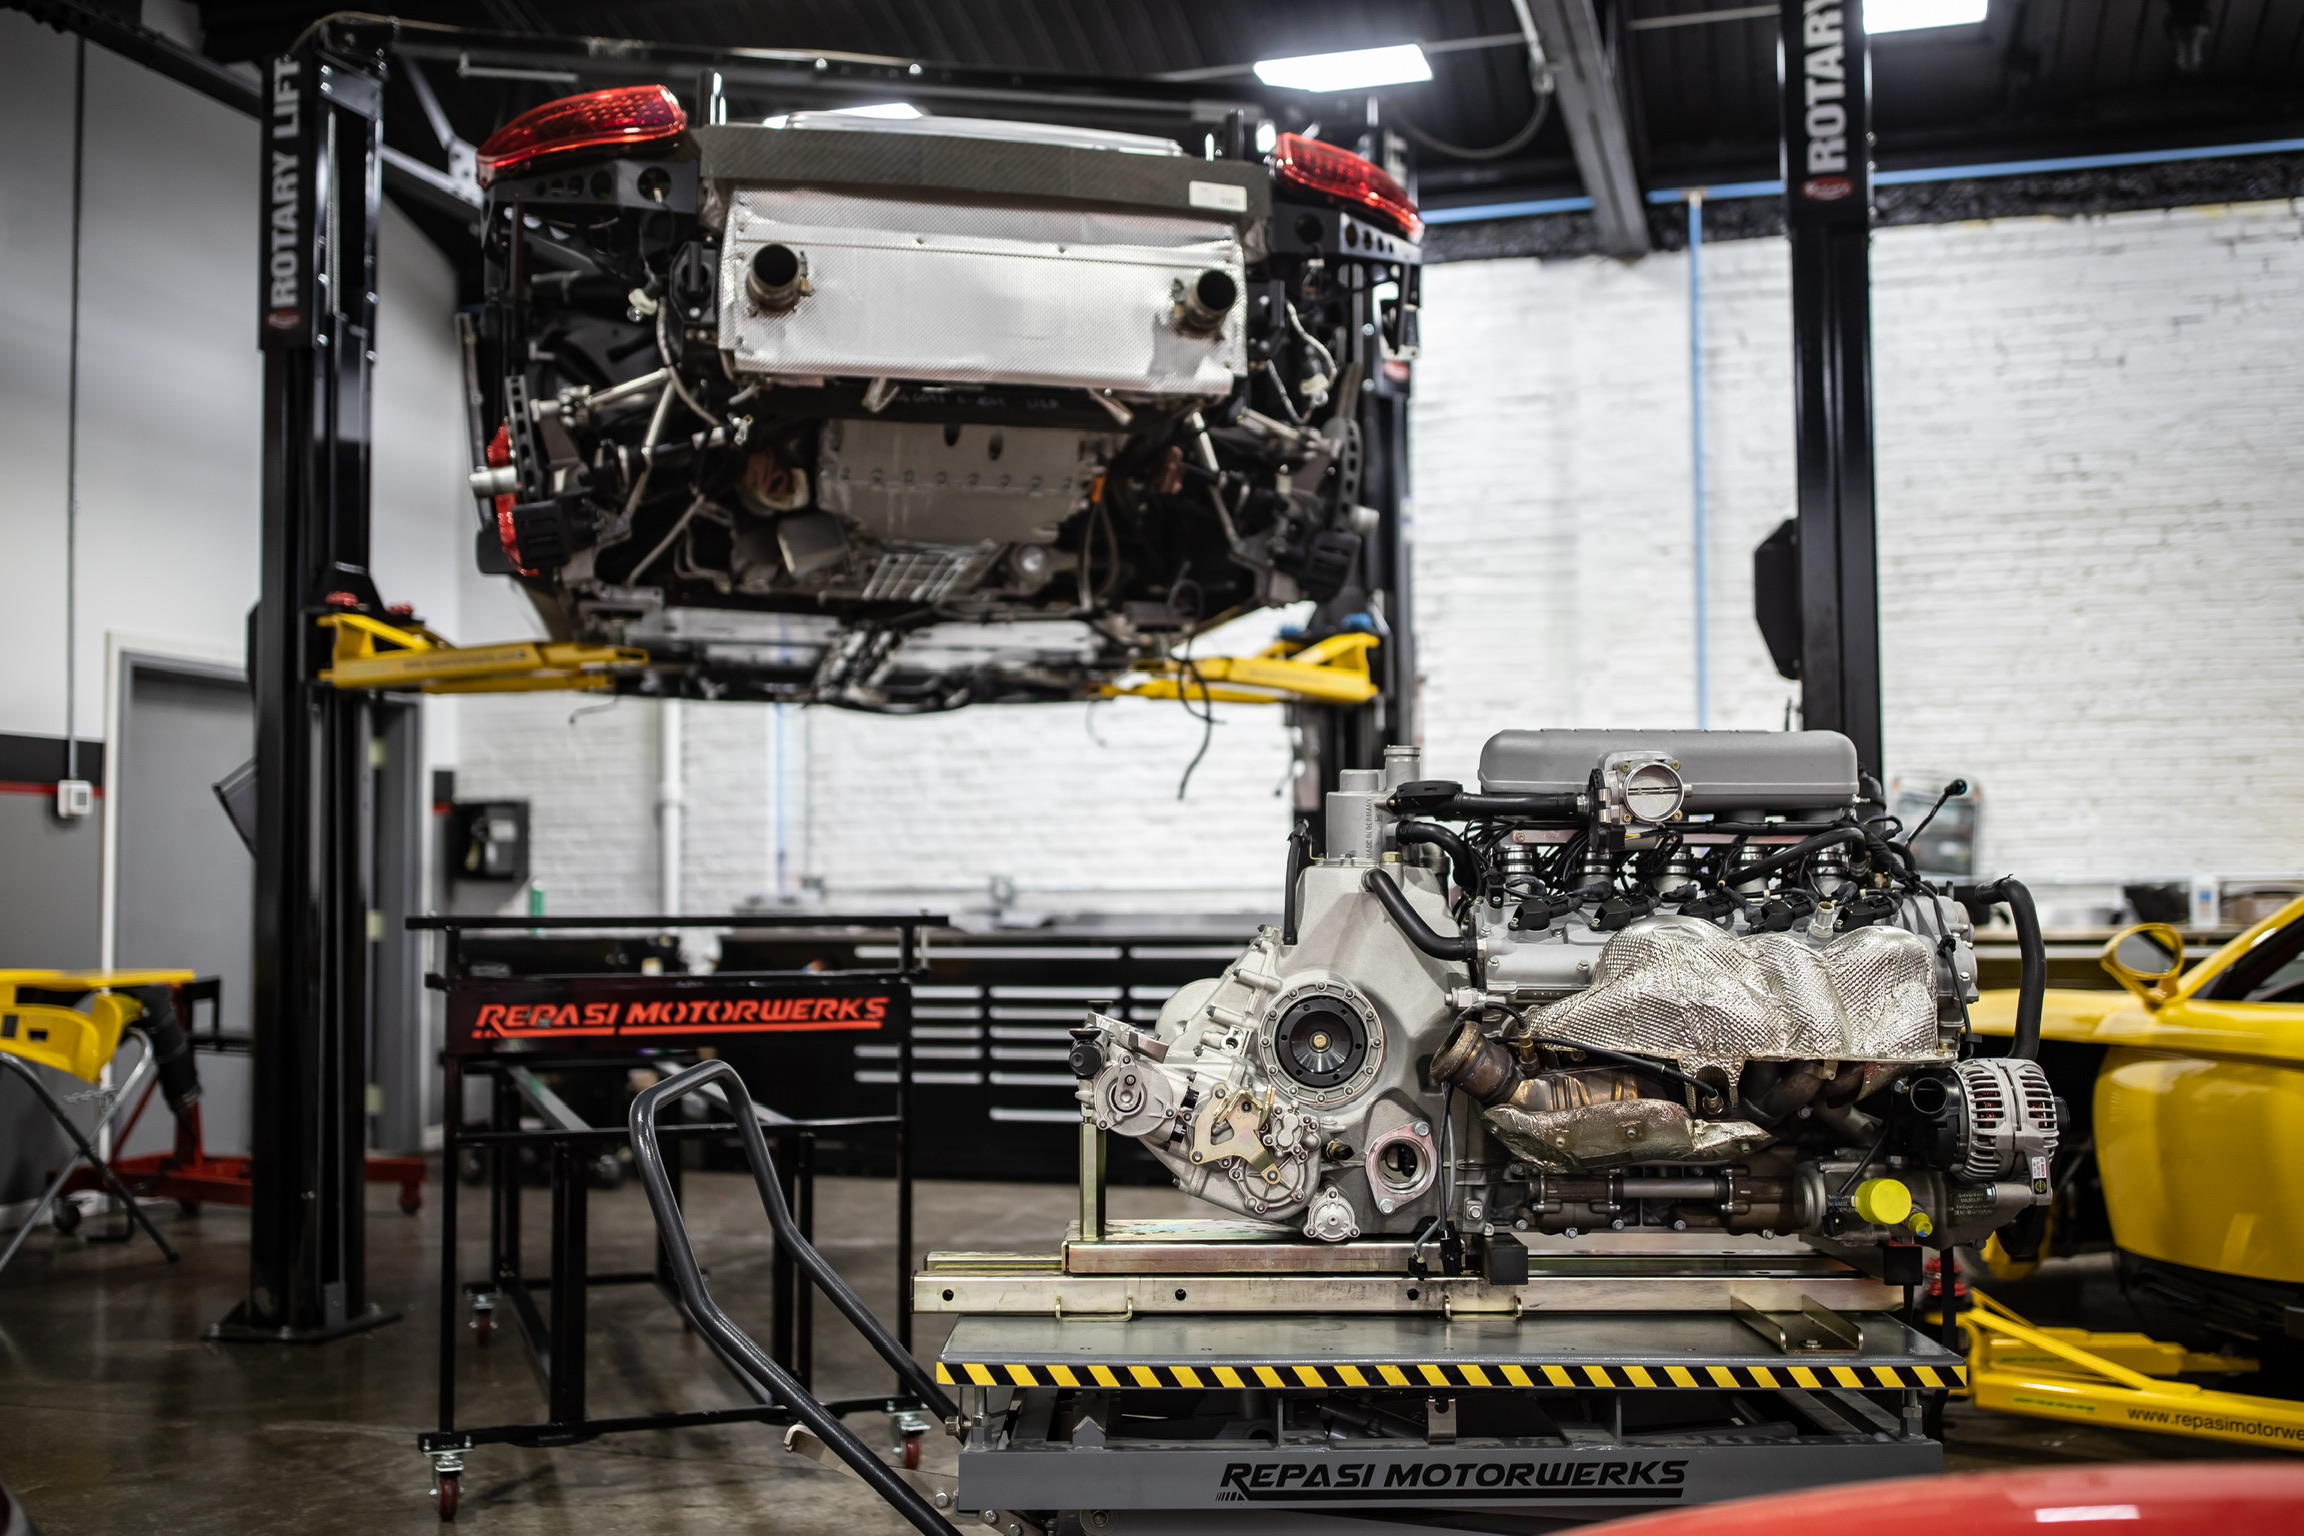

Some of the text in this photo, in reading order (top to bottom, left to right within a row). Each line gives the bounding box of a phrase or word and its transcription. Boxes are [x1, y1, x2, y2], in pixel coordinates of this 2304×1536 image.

[273, 57, 300, 139] LIFT
[270, 151, 300, 308] ROTARY
[1365, 797, 1373, 831] GERMANY
[1365, 839, 1373, 859] MADE
[474, 996, 891, 1029] REPASI MOTORWERKS
[1220, 1459, 1690, 1489] REPASI MOTORWERKS
